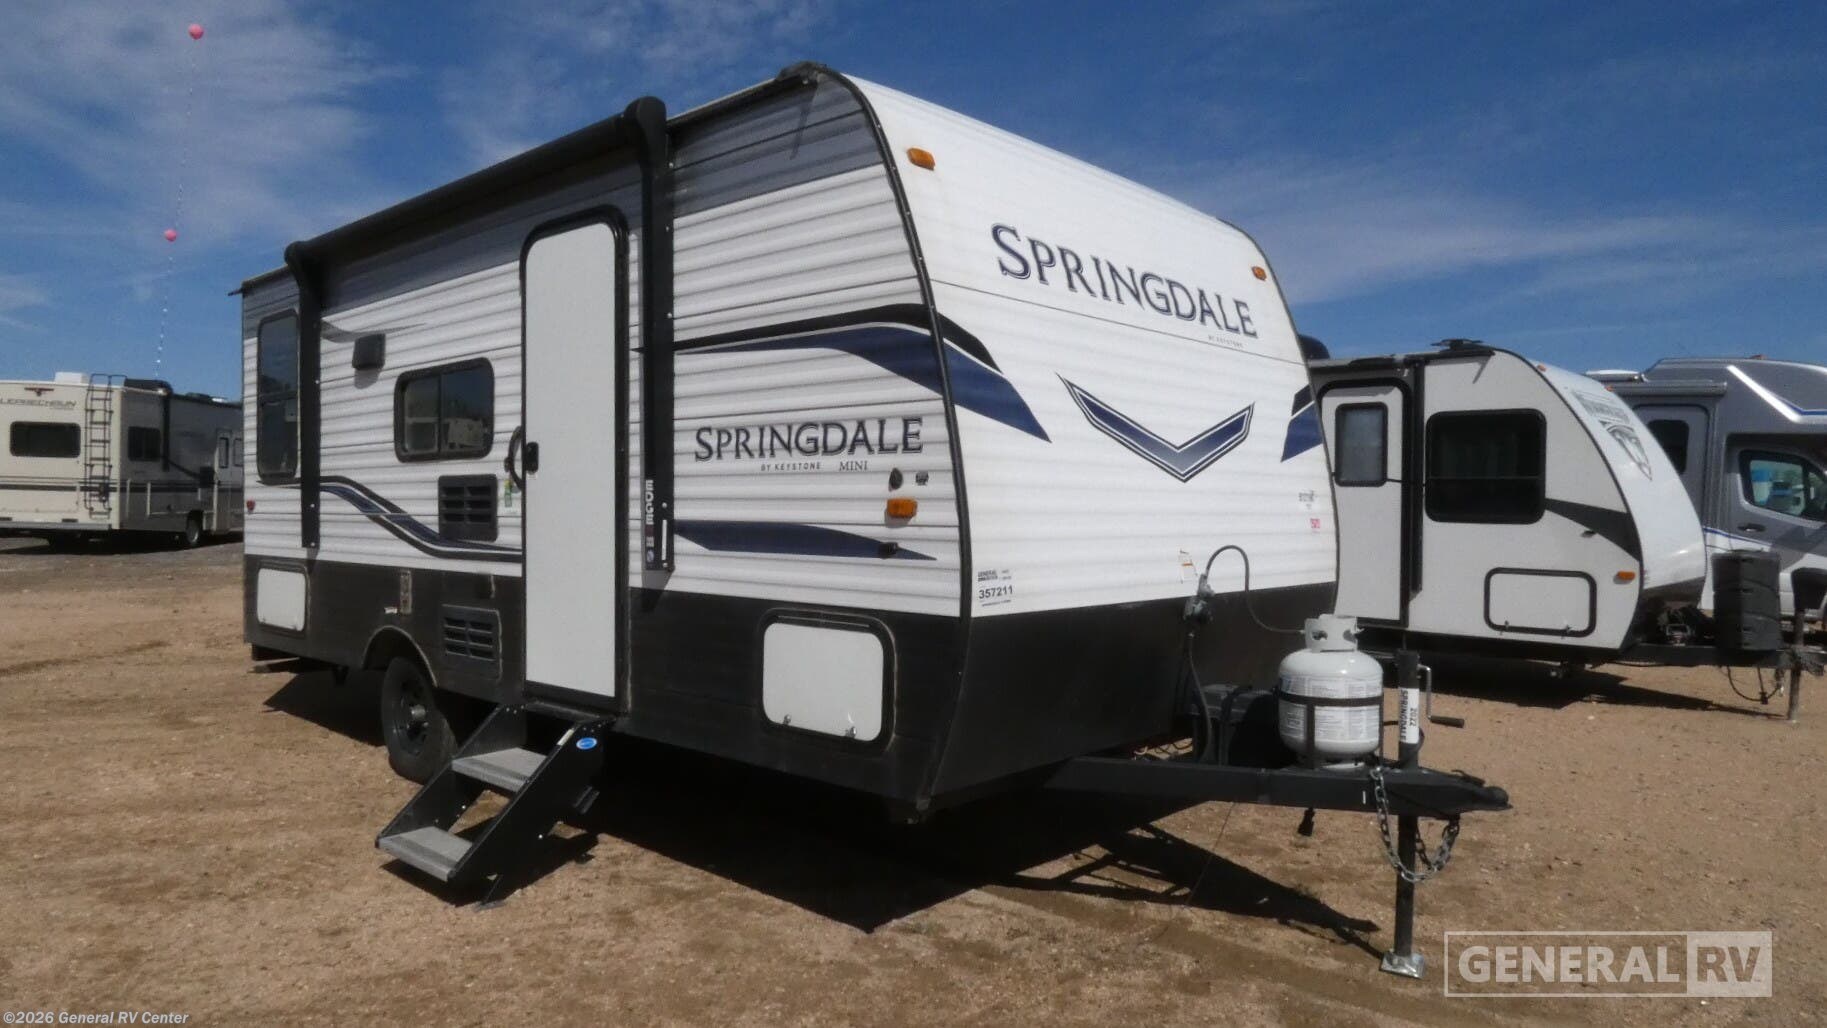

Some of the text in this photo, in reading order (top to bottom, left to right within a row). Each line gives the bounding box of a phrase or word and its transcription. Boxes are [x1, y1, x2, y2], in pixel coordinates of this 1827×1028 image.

[991, 223, 1258, 338] SPRINGDALE
[694, 416, 924, 462] SPRINGDALE
[761, 460, 869, 472] BY KEYSTONE MINI
[646, 479, 655, 525] EDGE
[979, 585, 1012, 599] 357211
